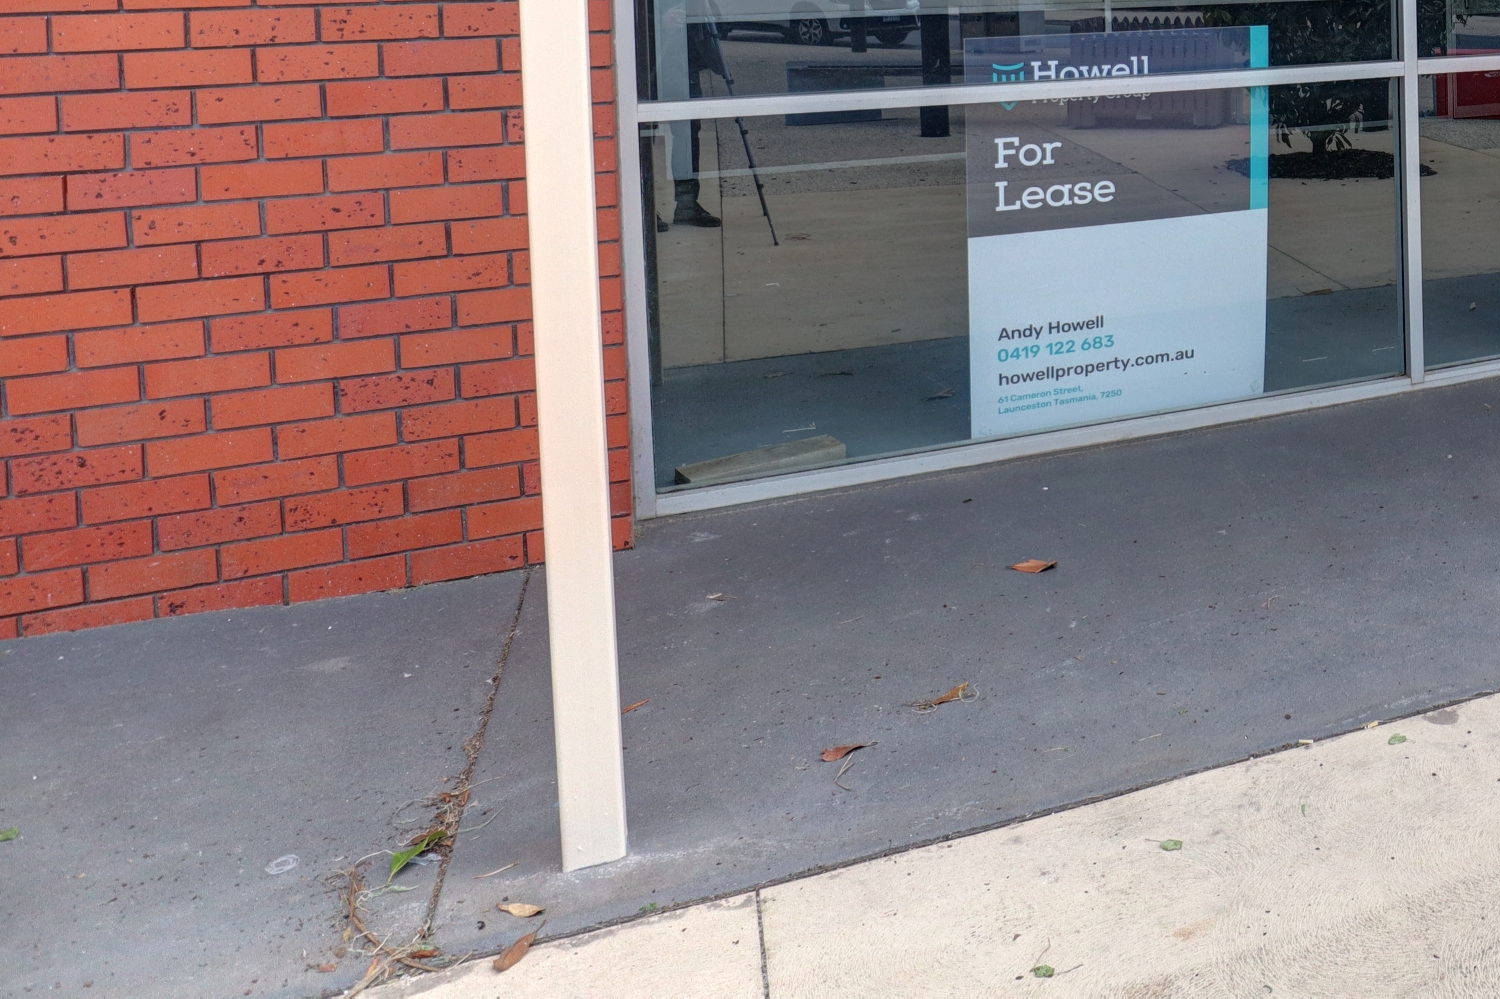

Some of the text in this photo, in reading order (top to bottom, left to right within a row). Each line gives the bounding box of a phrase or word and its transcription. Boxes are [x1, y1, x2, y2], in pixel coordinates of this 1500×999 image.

[1030, 55, 1149, 81] Howell
[994, 136, 1063, 169] For
[994, 180, 1116, 212] Lease
[997, 315, 1104, 342] Andy Howell
[997, 334, 1115, 363] 0419 122 683
[998, 349, 1195, 387] howellproperty.com.au
[997, 385, 1084, 404] 61 Cameron Street,
[997, 400, 1052, 415] Launceston
[1100, 389, 1123, 399] 7250
